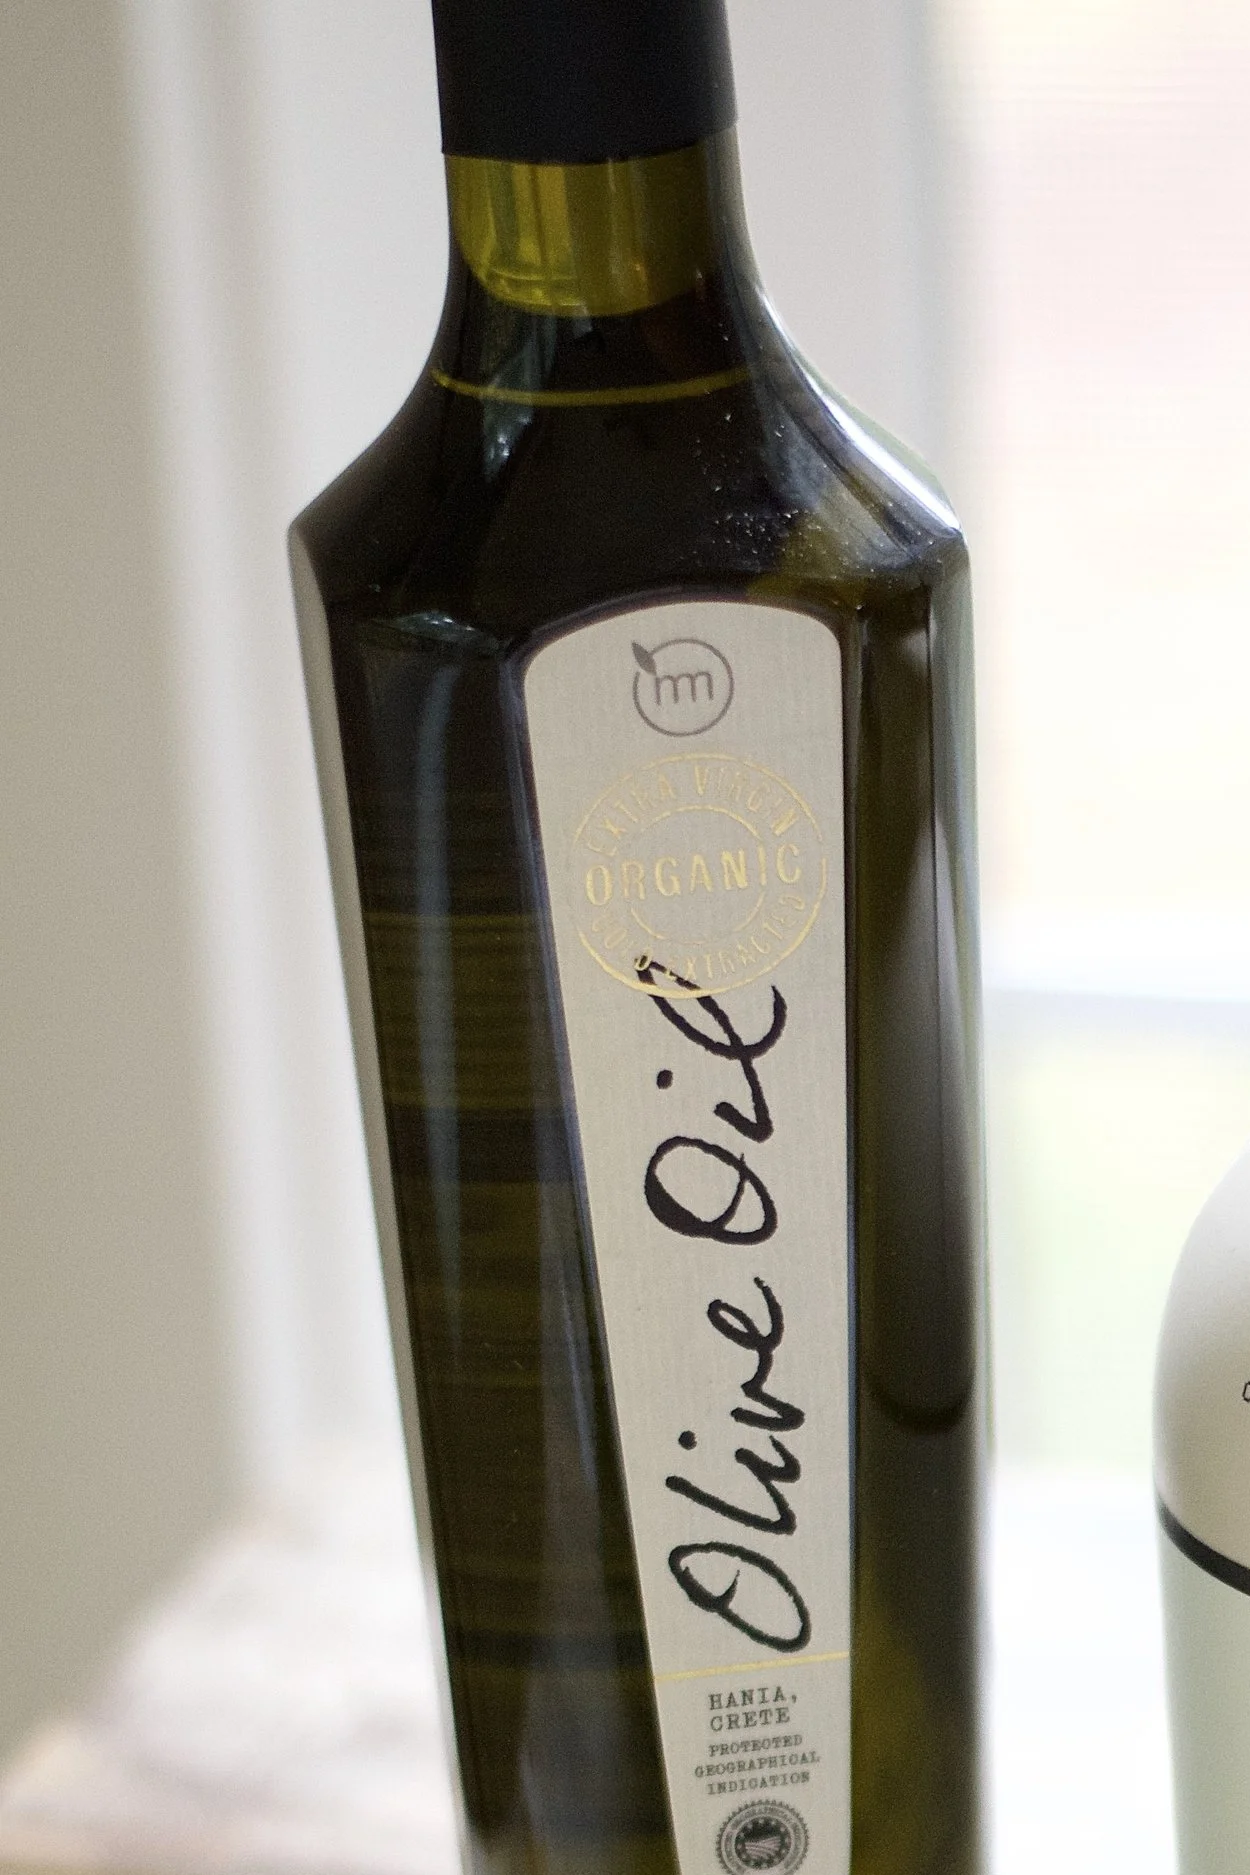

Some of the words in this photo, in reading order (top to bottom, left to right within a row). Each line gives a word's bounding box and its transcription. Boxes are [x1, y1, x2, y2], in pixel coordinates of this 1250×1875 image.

[587, 773, 676, 857] EXTRA
[694, 766, 799, 837] VIRGIN
[585, 844, 802, 906] ORGANIC
[635, 955, 790, 1246] Oil
[667, 1275, 813, 1654] Olive
[708, 1686, 797, 1710] HANIA,
[709, 1707, 791, 1732] CRETE
[708, 1734, 803, 1757] PROTECTED
[694, 1751, 821, 1778] GEOGRAPHICAL
[706, 1771, 810, 1795] INDICATION
